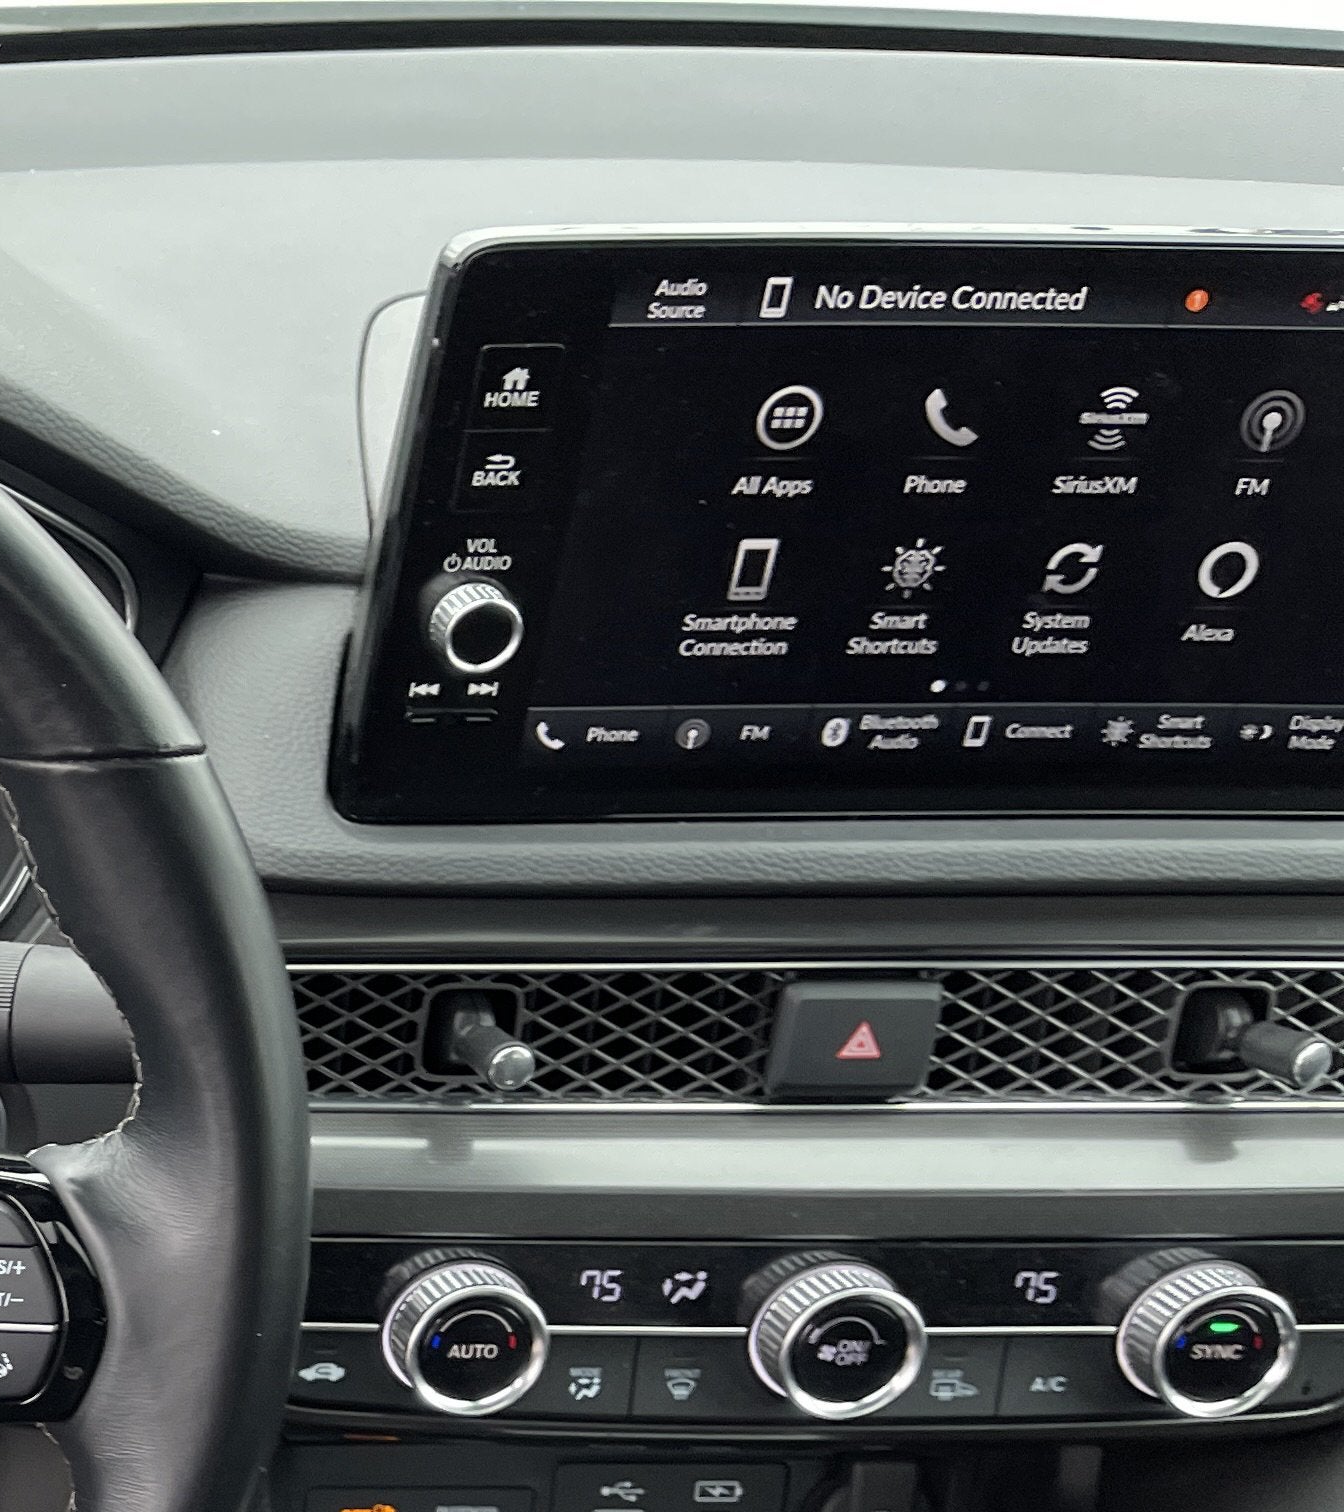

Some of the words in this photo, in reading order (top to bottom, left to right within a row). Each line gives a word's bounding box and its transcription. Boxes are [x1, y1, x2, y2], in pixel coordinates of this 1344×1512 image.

[655, 279, 709, 297] Audio
[815, 285, 854, 310] No
[859, 285, 946, 310] Device
[952, 285, 1089, 311] Connected
[647, 303, 707, 320] Source
[484, 391, 540, 408] HOME
[472, 470, 521, 487] BACK
[731, 477, 760, 495] All
[762, 477, 813, 498] Apps
[903, 475, 967, 494] Phone
[1052, 475, 1137, 494] SiriusXM
[1235, 478, 1270, 496] FM
[467, 538, 497, 553] VOL
[462, 556, 511, 571] AUDIO
[681, 613, 798, 634] Smartphone
[869, 613, 928, 630] Smart
[1022, 612, 1090, 632] System
[1181, 624, 1234, 642] Alexa
[679, 638, 788, 656] Connection
[846, 637, 938, 655] Shortcuts
[1012, 637, 1088, 657] Updates
[586, 726, 640, 742] Phone
[740, 726, 771, 741] FM
[580, 1269, 623, 1302] 75
[1014, 1270, 1060, 1304] 75
[447, 1343, 499, 1359] AUTO
[1189, 1344, 1245, 1361] SYNC
[1029, 1376, 1069, 1393] A/C
